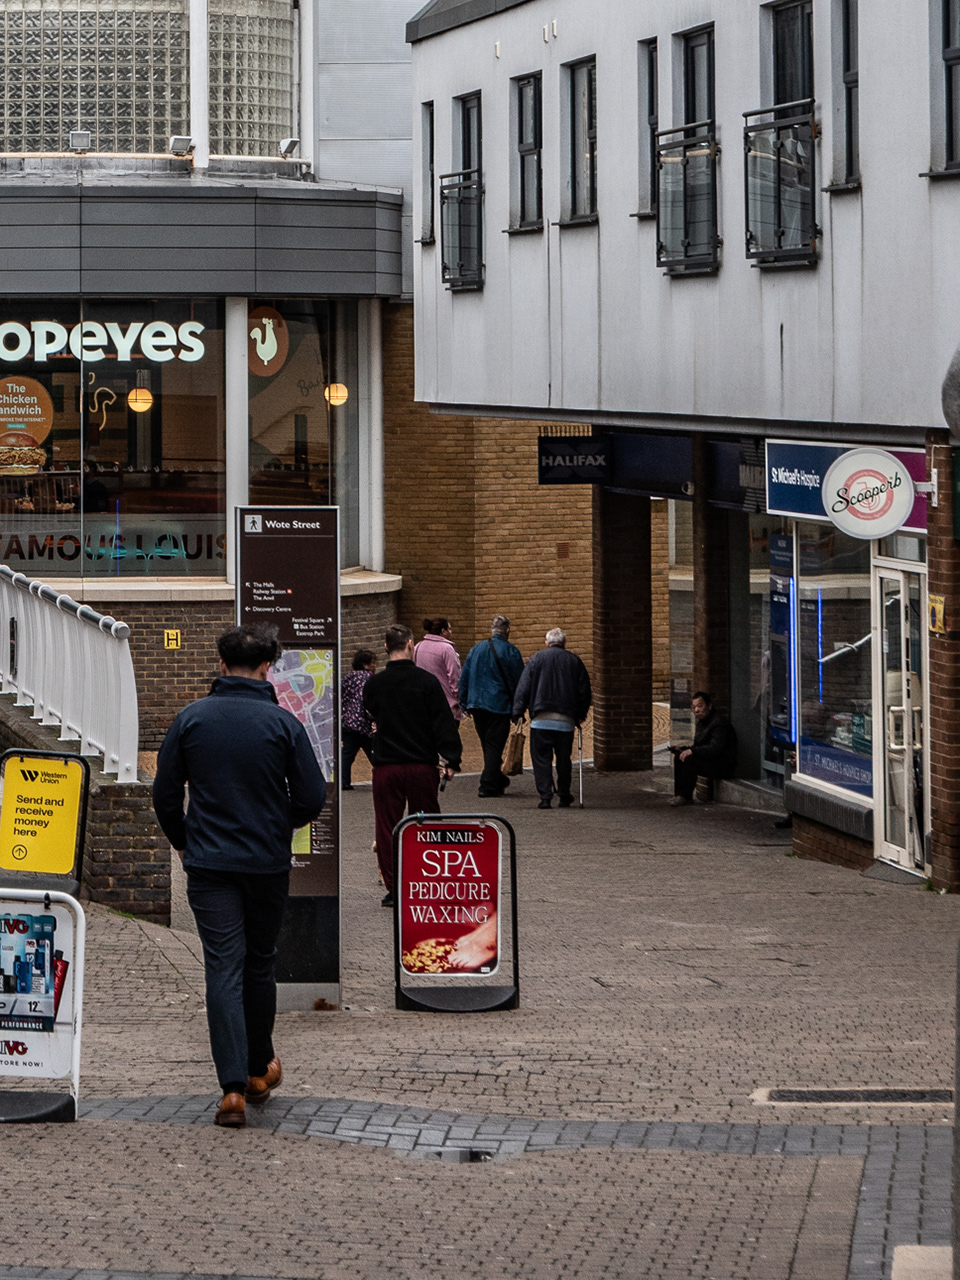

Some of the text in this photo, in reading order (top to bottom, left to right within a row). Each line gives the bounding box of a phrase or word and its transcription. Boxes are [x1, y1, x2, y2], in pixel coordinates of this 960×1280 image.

[7, 384, 26, 393] The
[541, 455, 606, 466] HALIFAX
[800, 470, 820, 491] Hospice
[831, 471, 902, 513] Scooperb
[265, 520, 320, 529] Wote Street
[167, 632, 179, 647] H
[40, 771, 67, 779] Western
[16, 794, 64, 807] Send and
[15, 807, 53, 817] receive
[14, 818, 50, 829] money
[13, 827, 37, 837] here
[417, 831, 485, 843] KIM NAILS
[421, 849, 482, 877] SPA
[409, 881, 490, 900] PEDICURE
[409, 905, 489, 924] WAXING
[28, 1001, 38, 1013] 12
[1, 1021, 43, 1030] PERFORMANCE
[0, 1040, 29, 1055] IVG
